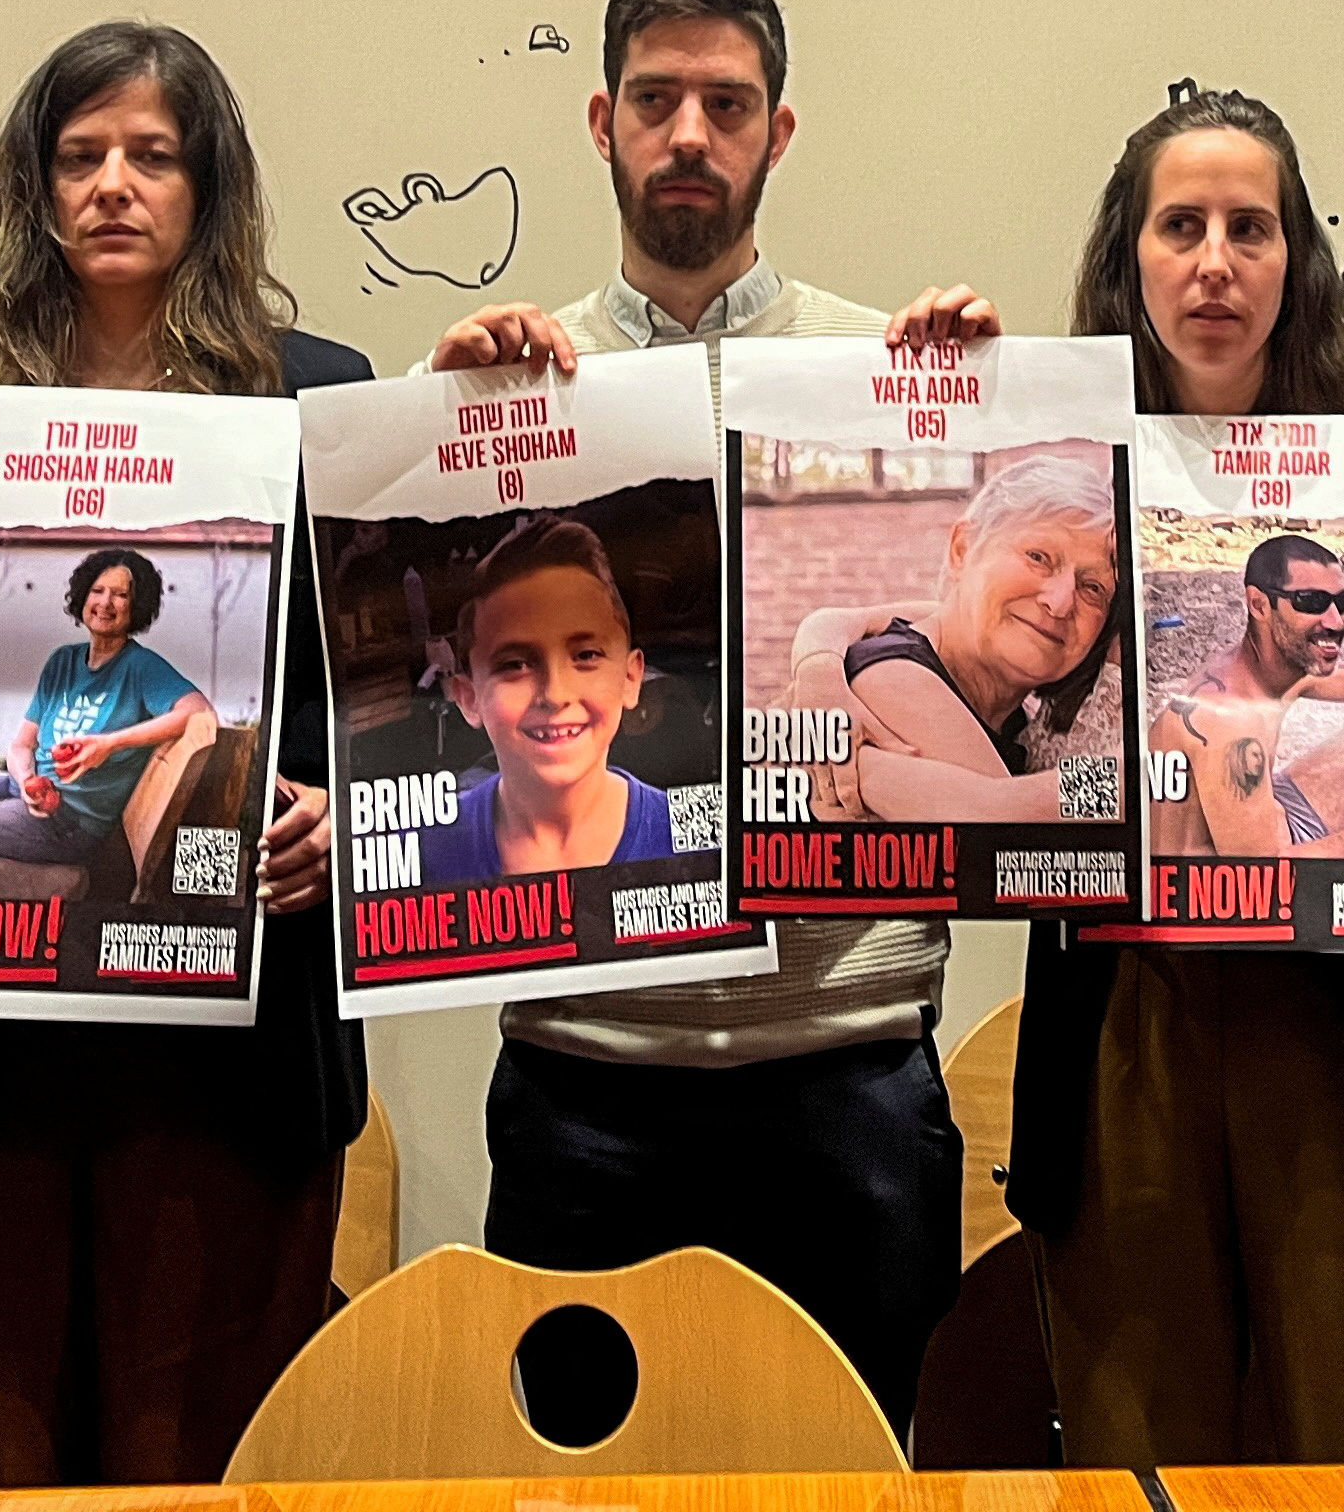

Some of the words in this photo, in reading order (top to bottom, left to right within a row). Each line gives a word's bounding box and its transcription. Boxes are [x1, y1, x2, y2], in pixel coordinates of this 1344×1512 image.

[871, 376, 920, 404] YAFA
[927, 376, 980, 404] ADAR
[458, 402, 504, 435] שהם
[510, 397, 547, 429] נווה
[907, 408, 946, 442] (85)
[45, 420, 78, 450] הרן
[86, 422, 137, 450] שושן
[438, 440, 487, 474] NEVE
[492, 428, 577, 466] SHOHAM
[3, 454, 98, 483] SHOSHAN
[104, 457, 174, 485] HARAN
[1211, 450, 1271, 475] TAMIR
[1278, 451, 1331, 476] ADAR
[64, 486, 106, 519] (66)
[496, 468, 525, 505] (8)
[1252, 478, 1291, 509] (38)
[742, 707, 851, 764] BRING
[349, 770, 458, 836] BRING
[742, 765, 811, 822] HER
[353, 831, 421, 893] HIM
[742, 832, 842, 888] HOME
[853, 826, 956, 889] NOW!
[996, 851, 1051, 871] HOSTAGES
[1053, 851, 1074, 871] AND
[1076, 851, 1125, 872] MISSING
[612, 885, 669, 911] HOSTAGES
[670, 883, 695, 904] AND
[695, 880, 722, 902] MISS
[996, 870, 1066, 897] FAMILIES
[1069, 870, 1126, 898] FORUM
[1188, 859, 1293, 921] NOW!
[355, 893, 458, 959] HOME
[467, 873, 575, 945] NOW!
[614, 904, 688, 939] FAMILIES
[690, 900, 724, 930] FOR
[101, 922, 160, 947] HOSTAGES
[160, 925, 186, 947] AND
[186, 925, 238, 949] MISSING
[98, 943, 174, 974] FAMILIES
[175, 946, 236, 976] FORUM
